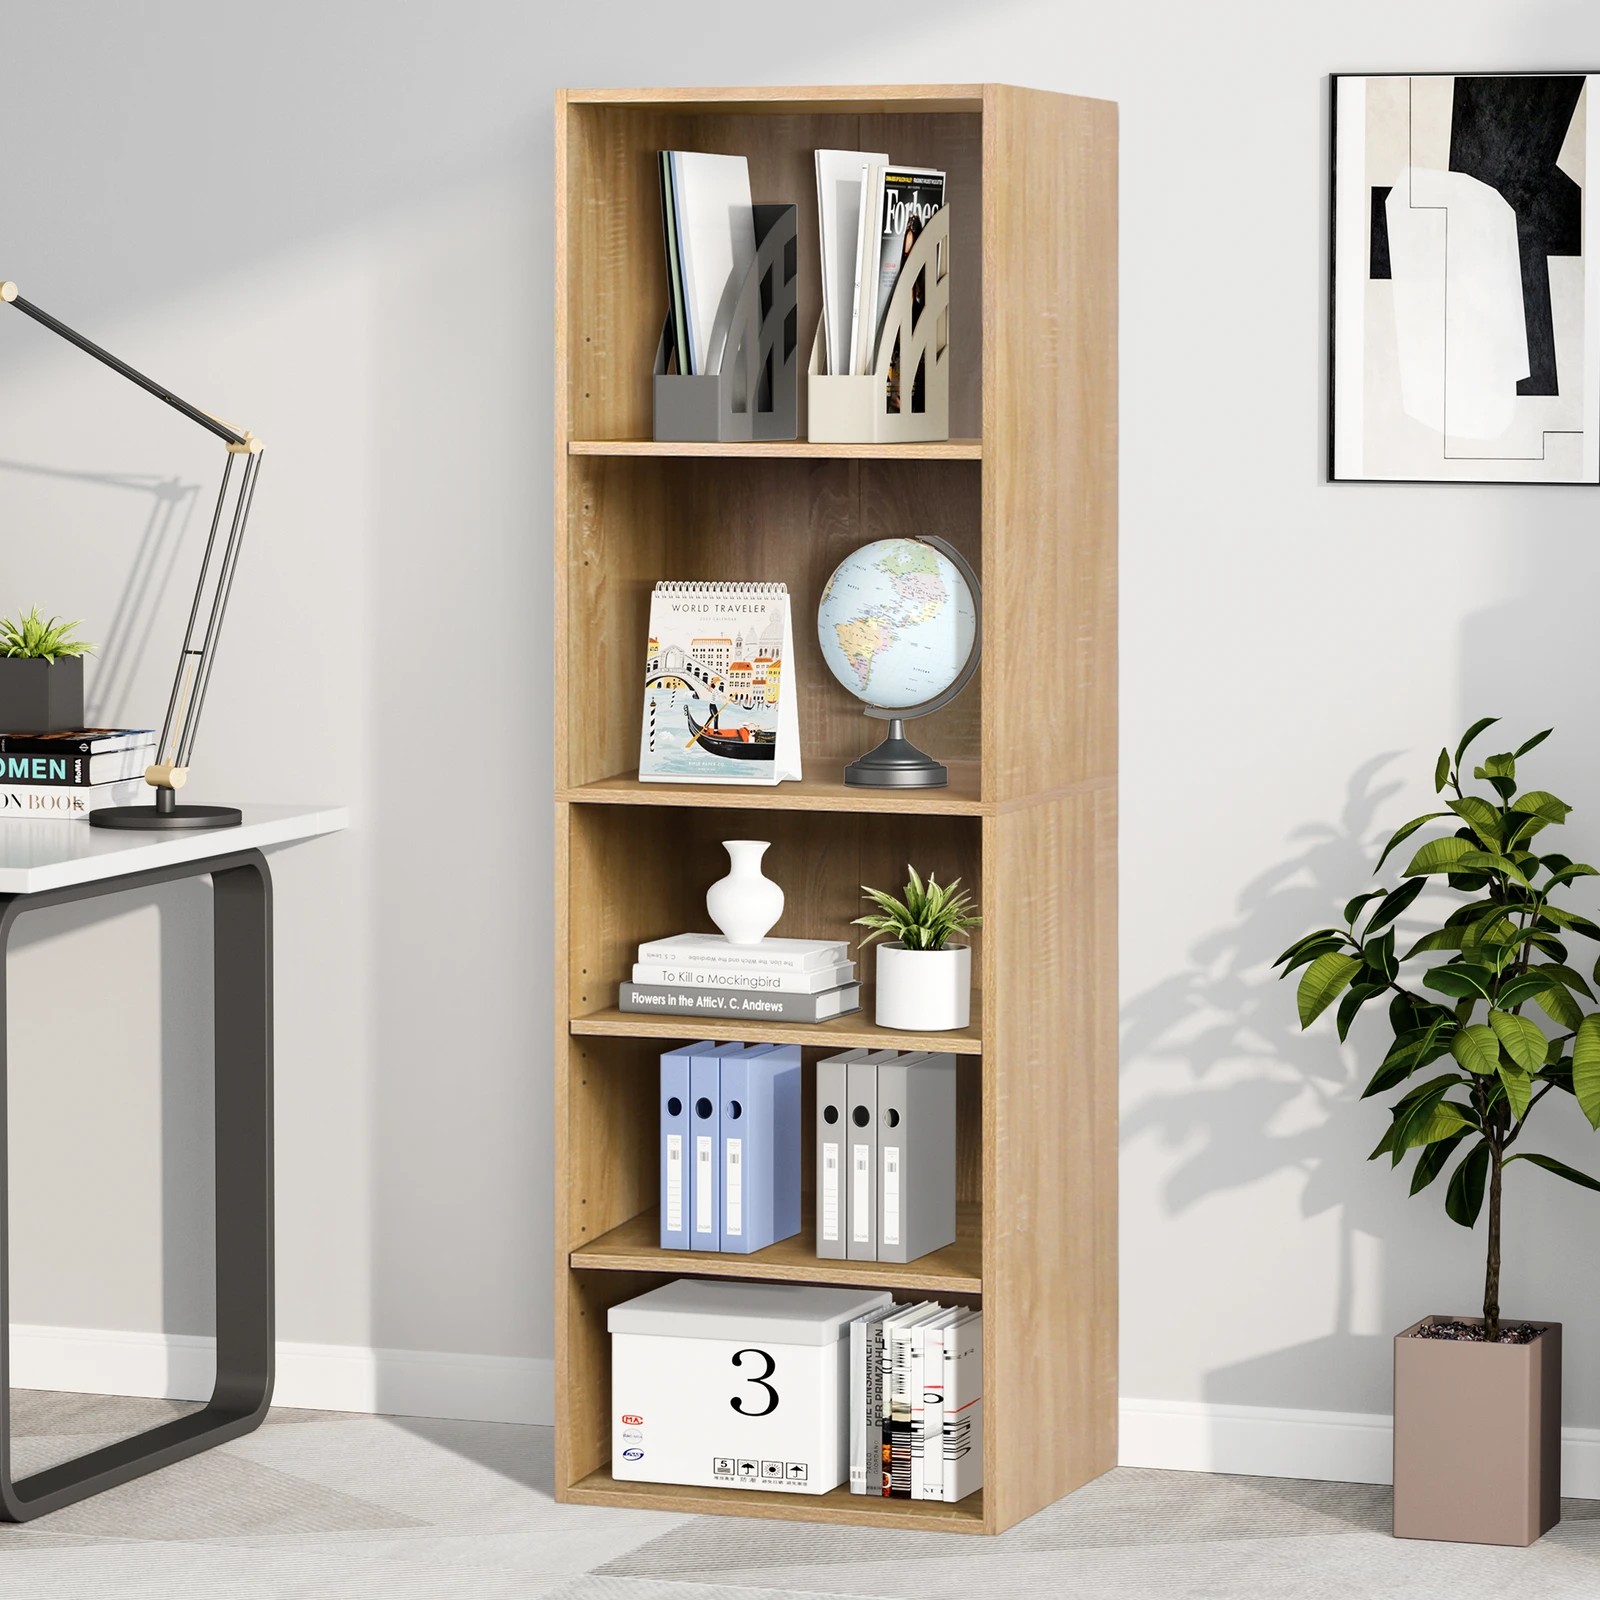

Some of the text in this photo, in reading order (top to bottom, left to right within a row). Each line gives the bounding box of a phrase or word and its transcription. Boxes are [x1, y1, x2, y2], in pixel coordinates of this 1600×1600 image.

[884, 189, 939, 235] Forbe
[671, 604, 766, 613] WORLD TRAVELER
[29, 795, 84, 811] BOOK
[662, 971, 781, 989] To Kill a Mockingbird
[631, 992, 666, 1005] Flowers
[668, 994, 677, 1006] in
[679, 995, 694, 1007] the
[729, 998, 740, 1010] C.
[742, 999, 783, 1012] Andrews
[730, 1349, 779, 1416] 3
[875, 1329, 883, 1427] DER PRIMZAHLEN
